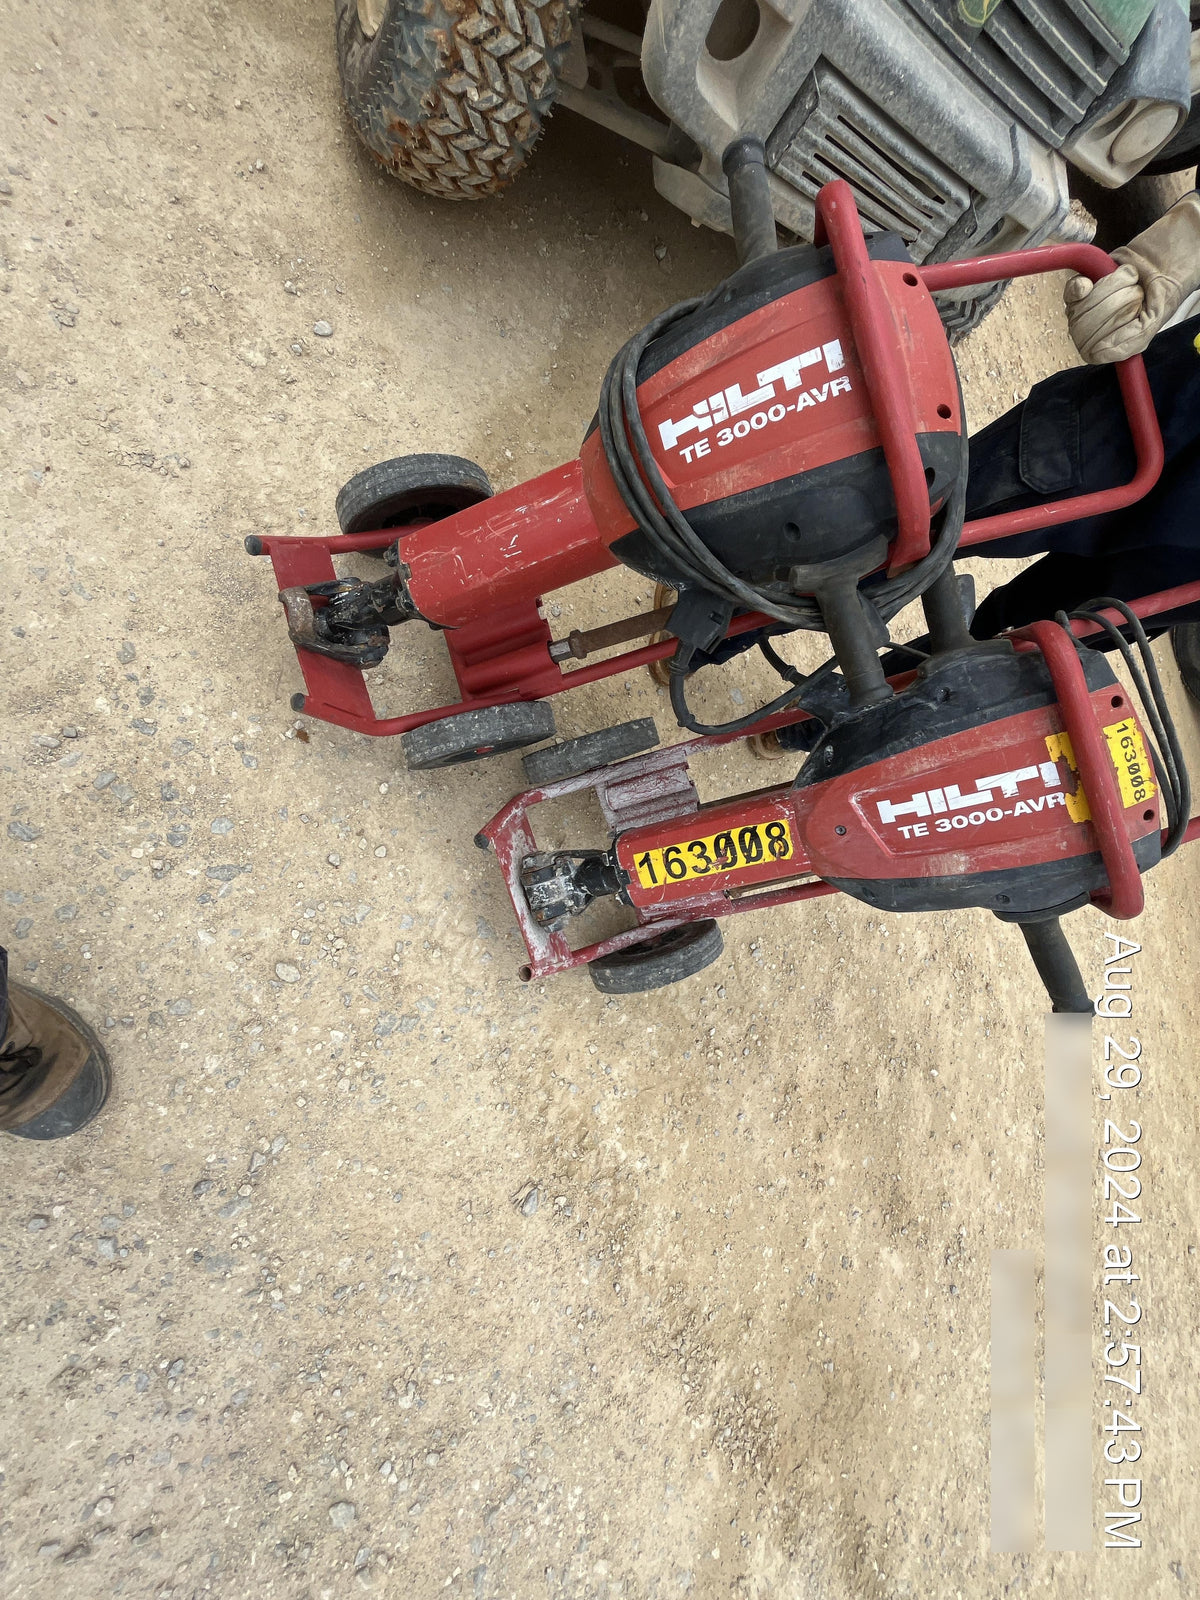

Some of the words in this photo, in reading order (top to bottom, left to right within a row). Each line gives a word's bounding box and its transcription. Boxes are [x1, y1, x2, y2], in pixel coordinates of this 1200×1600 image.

[658, 338, 846, 451] HILTI
[679, 437, 712, 464] TE
[716, 375, 853, 447] 3000-AVR
[876, 761, 1062, 824] HILTI
[897, 822, 930, 840] TE
[934, 791, 1066, 834] 3000-AVR
